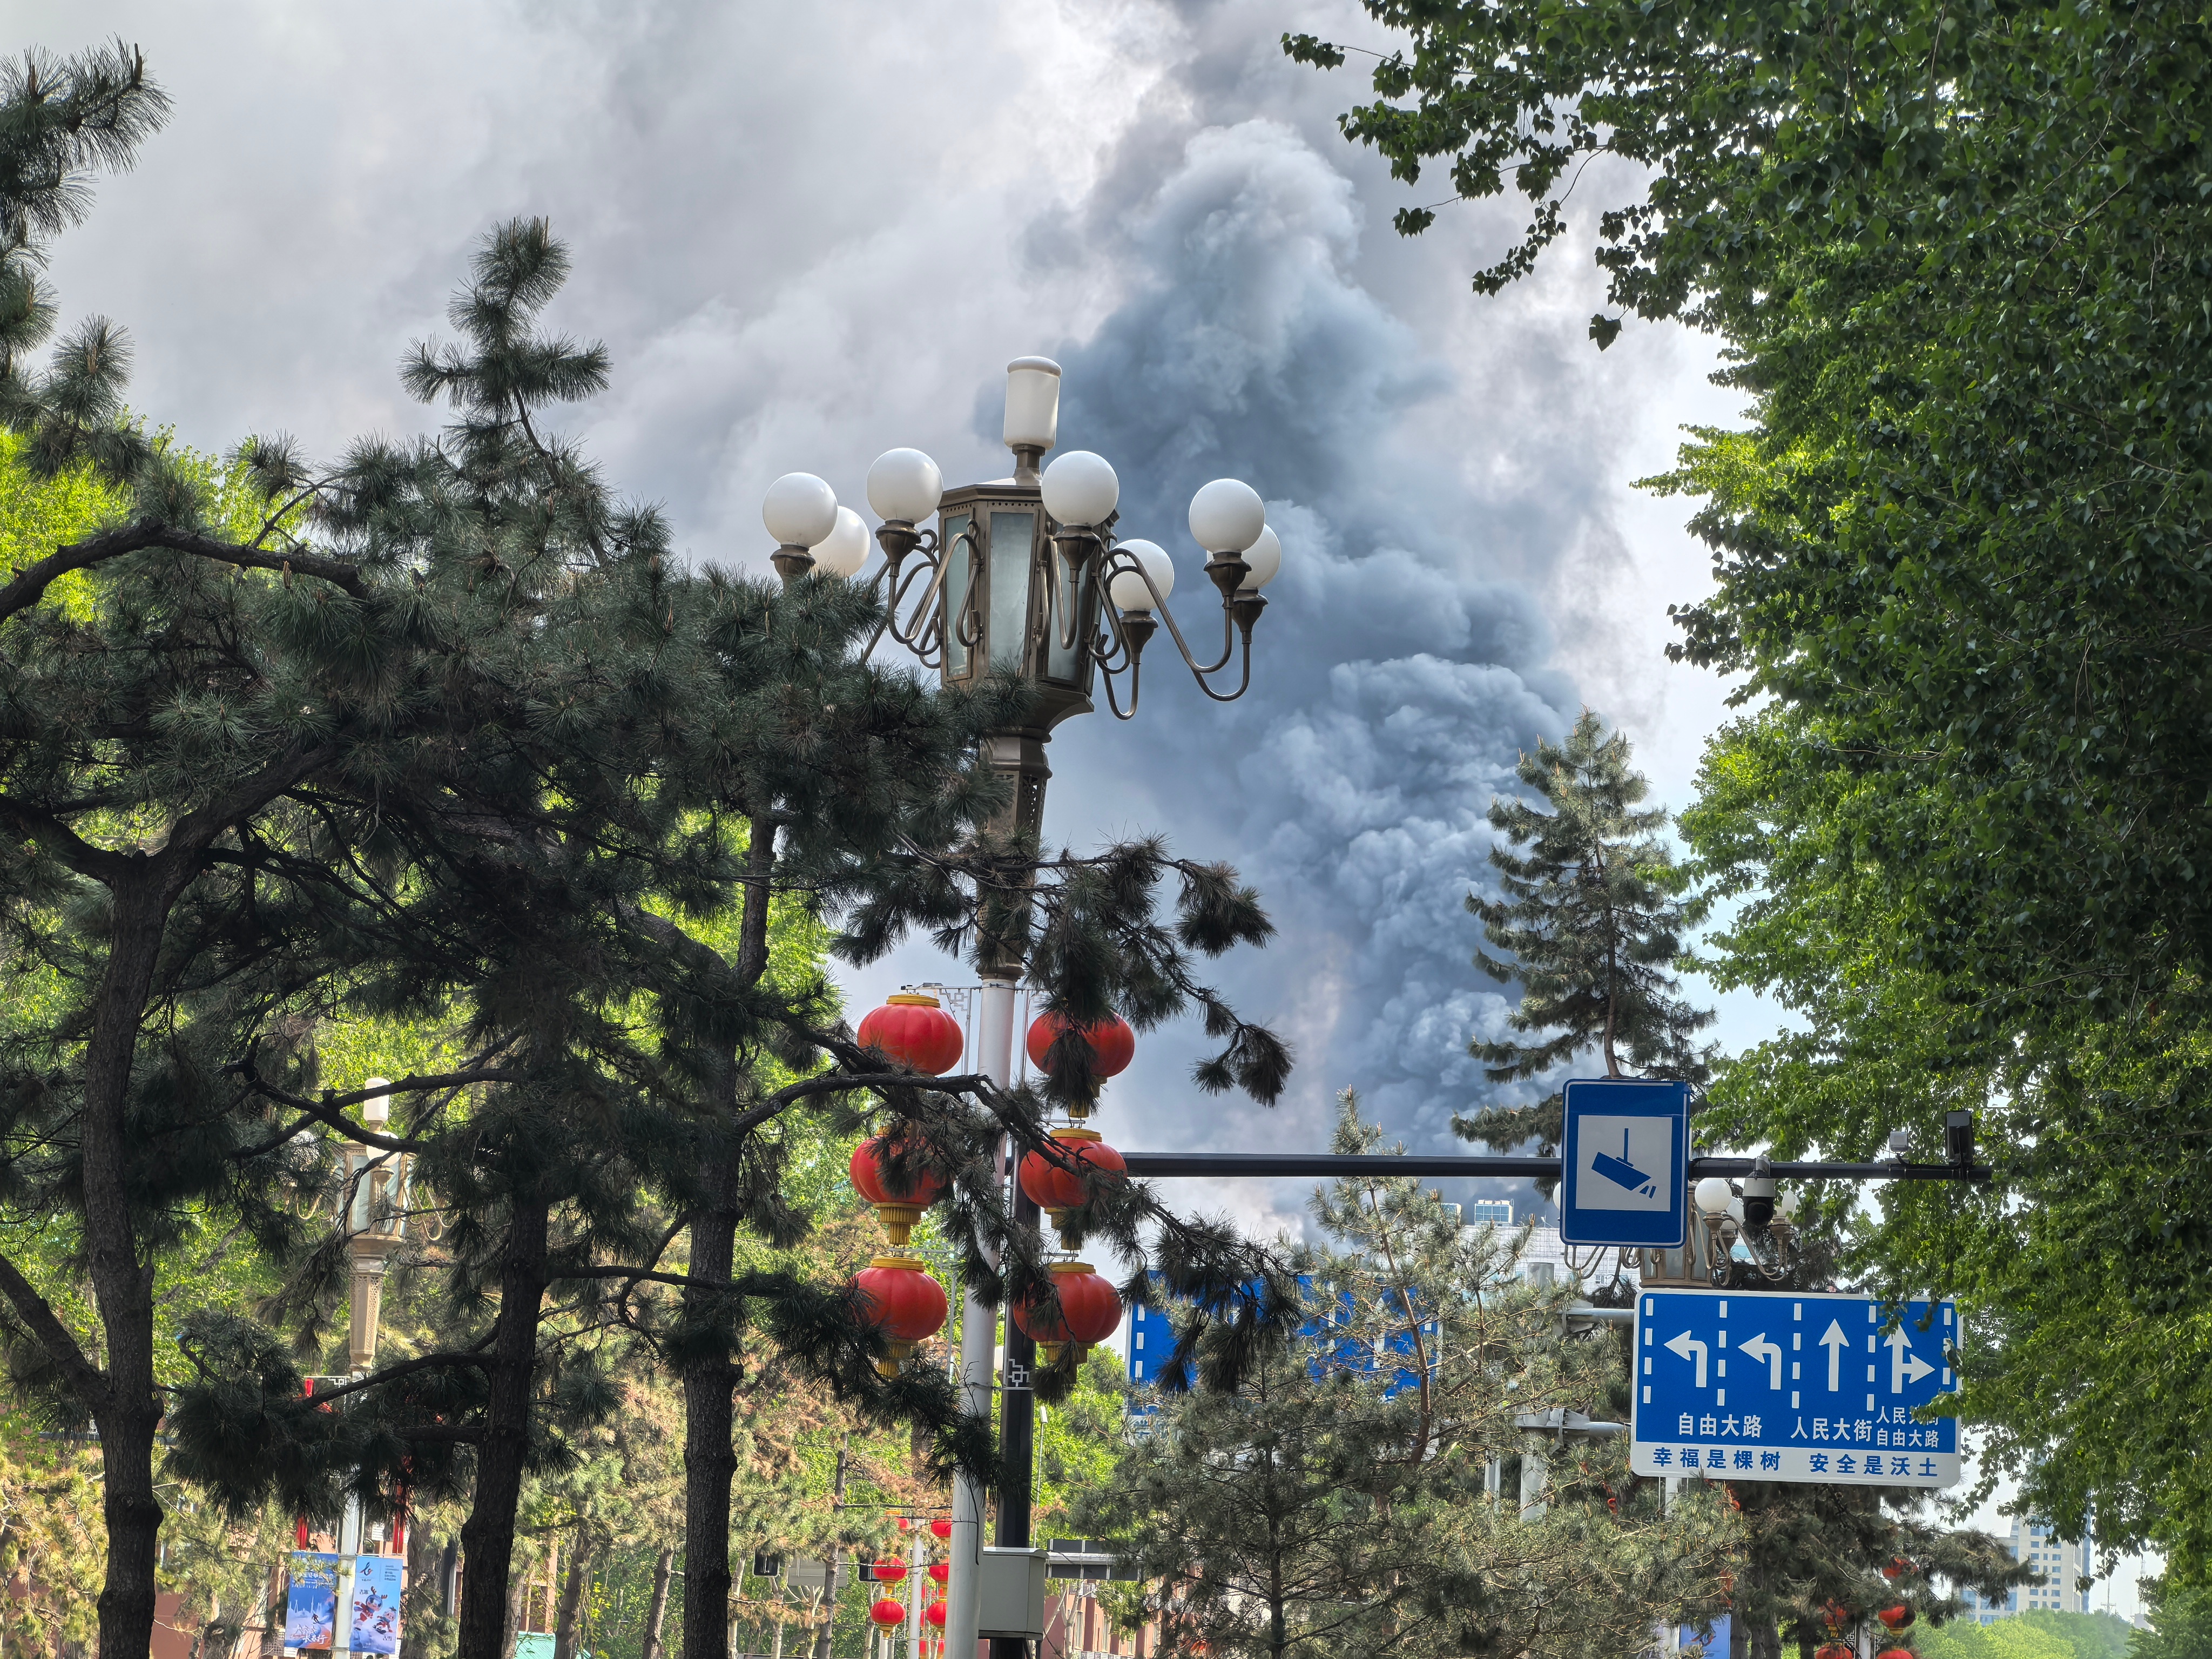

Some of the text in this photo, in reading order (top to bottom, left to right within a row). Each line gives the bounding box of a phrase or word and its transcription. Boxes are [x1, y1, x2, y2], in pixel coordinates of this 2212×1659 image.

[1678, 1412, 1763, 1438] 自由大路
[1790, 1416, 1872, 1442] 人民大街
[1877, 1428, 1939, 1448] 自由大路
[1653, 1447, 1938, 1478] 幸福是棵树 安全是沃土
